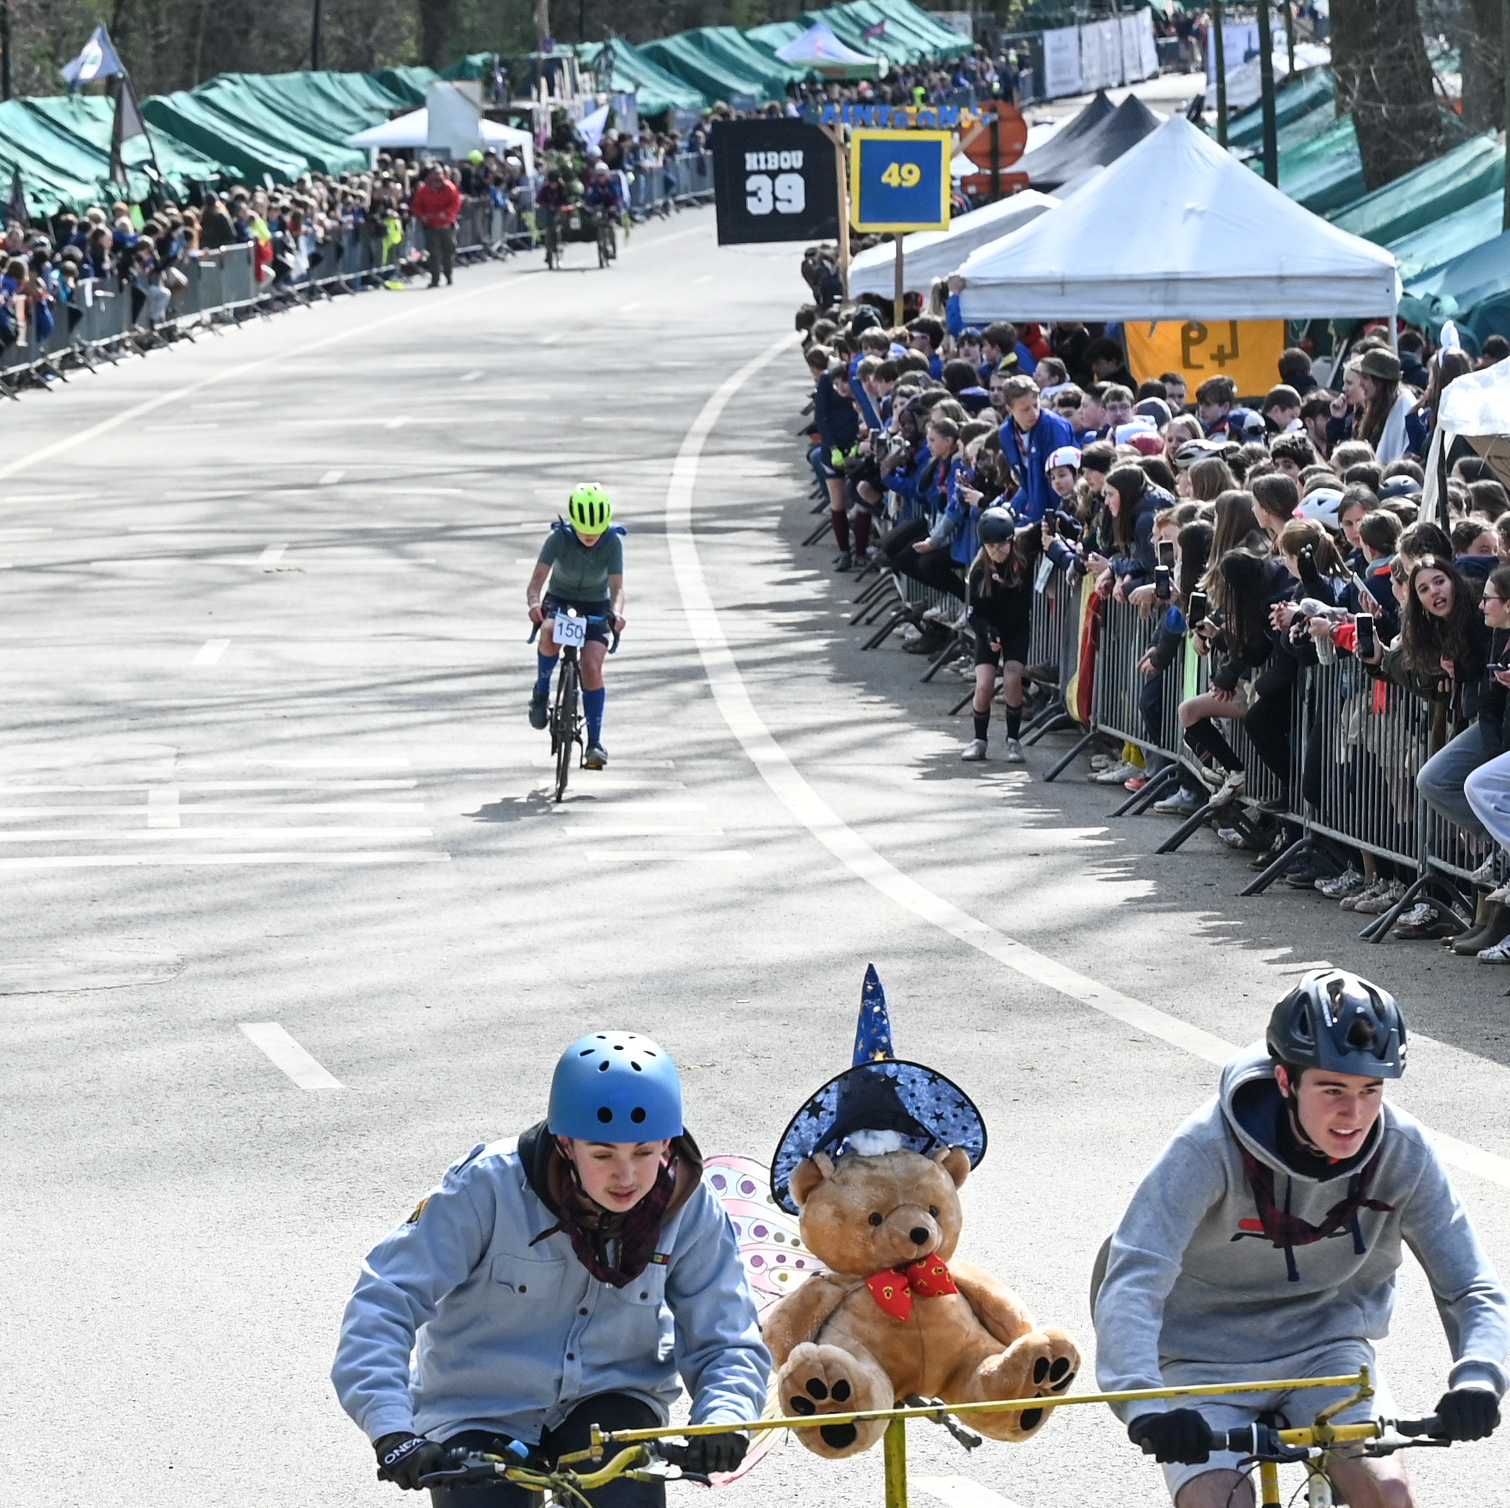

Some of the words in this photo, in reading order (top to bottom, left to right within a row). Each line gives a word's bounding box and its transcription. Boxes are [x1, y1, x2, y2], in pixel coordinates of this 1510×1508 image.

[745, 150, 804, 171] HIBOU
[881, 162, 921, 187] 49
[745, 172, 805, 215] 39
[557, 622, 584, 640] 150
